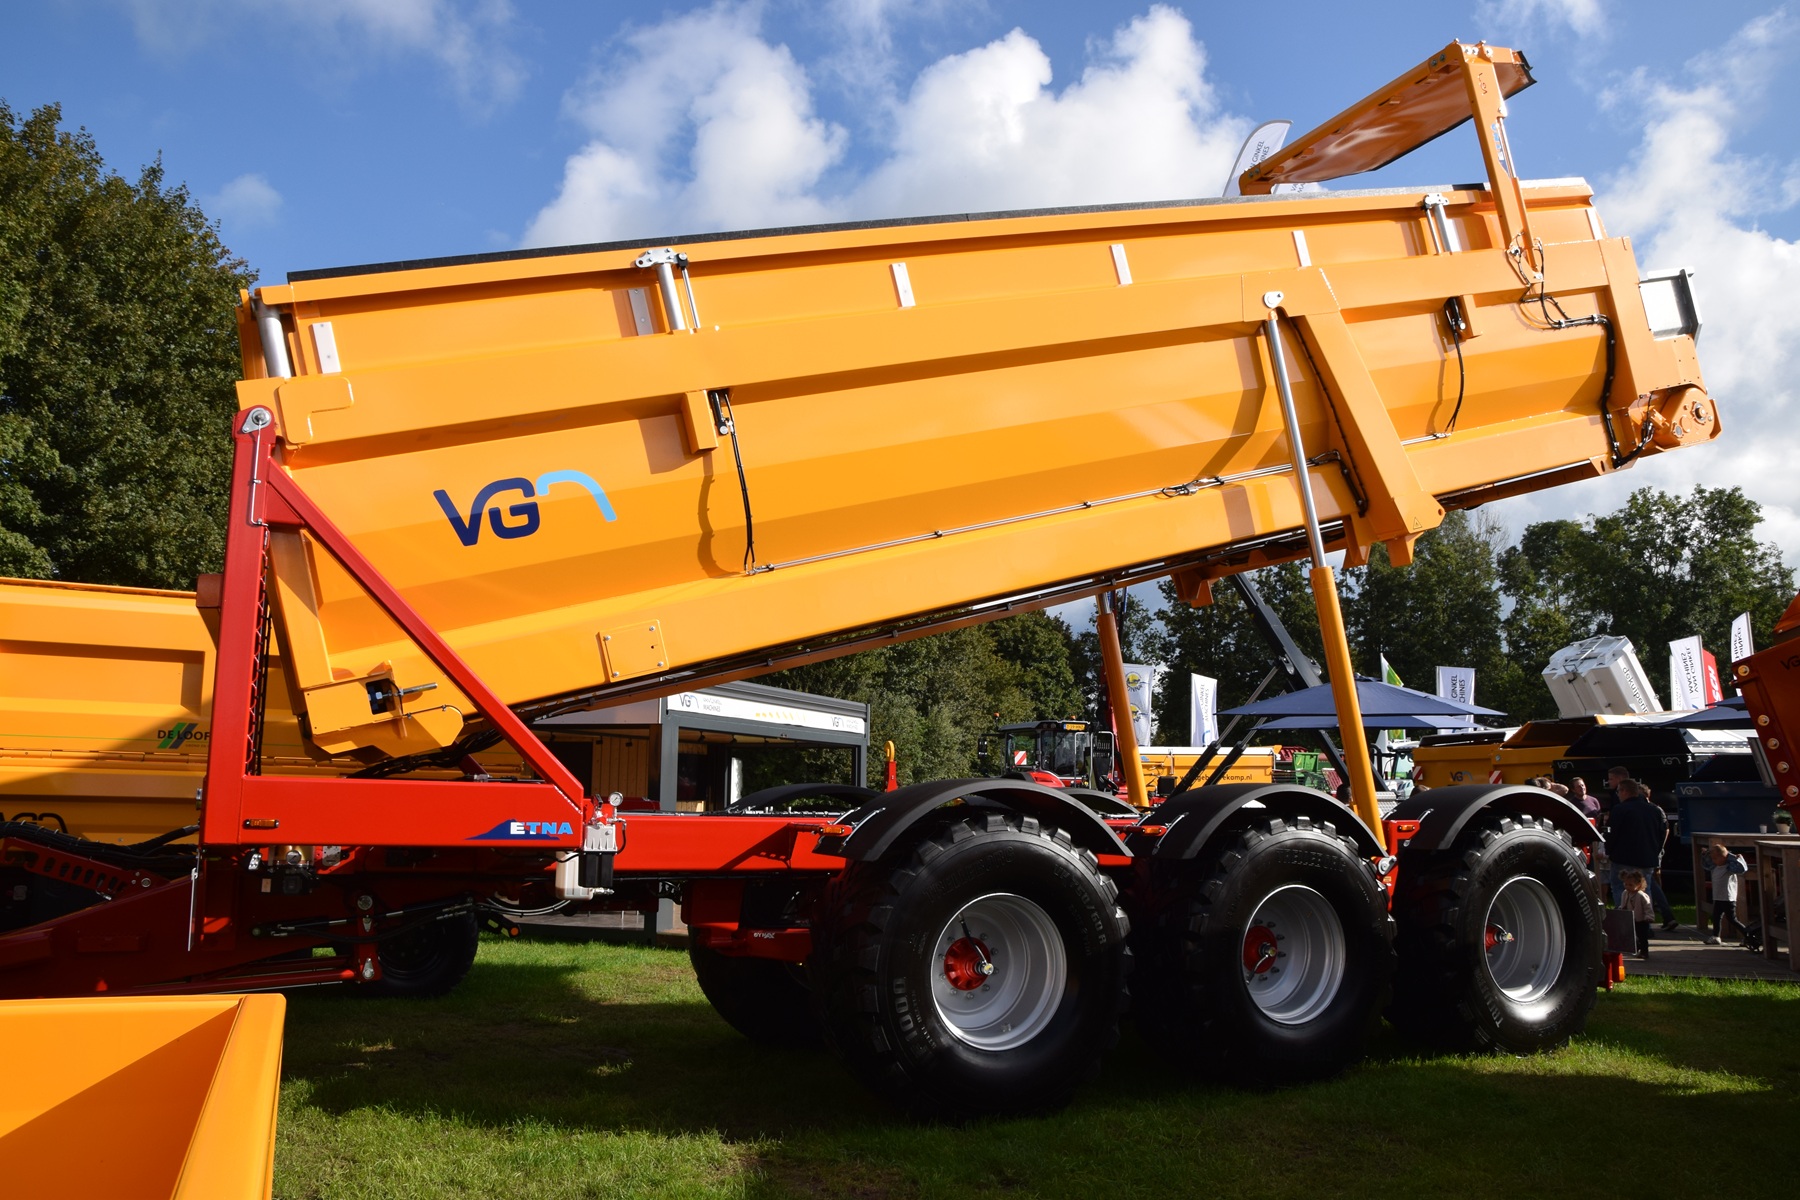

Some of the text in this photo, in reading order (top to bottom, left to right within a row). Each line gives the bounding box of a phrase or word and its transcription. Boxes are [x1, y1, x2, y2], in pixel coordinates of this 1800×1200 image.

[1252, 141, 1265, 162] GINKEL
[1259, 146, 1270, 161] INES
[157, 730, 174, 739] DE
[510, 822, 573, 834] ETNA
